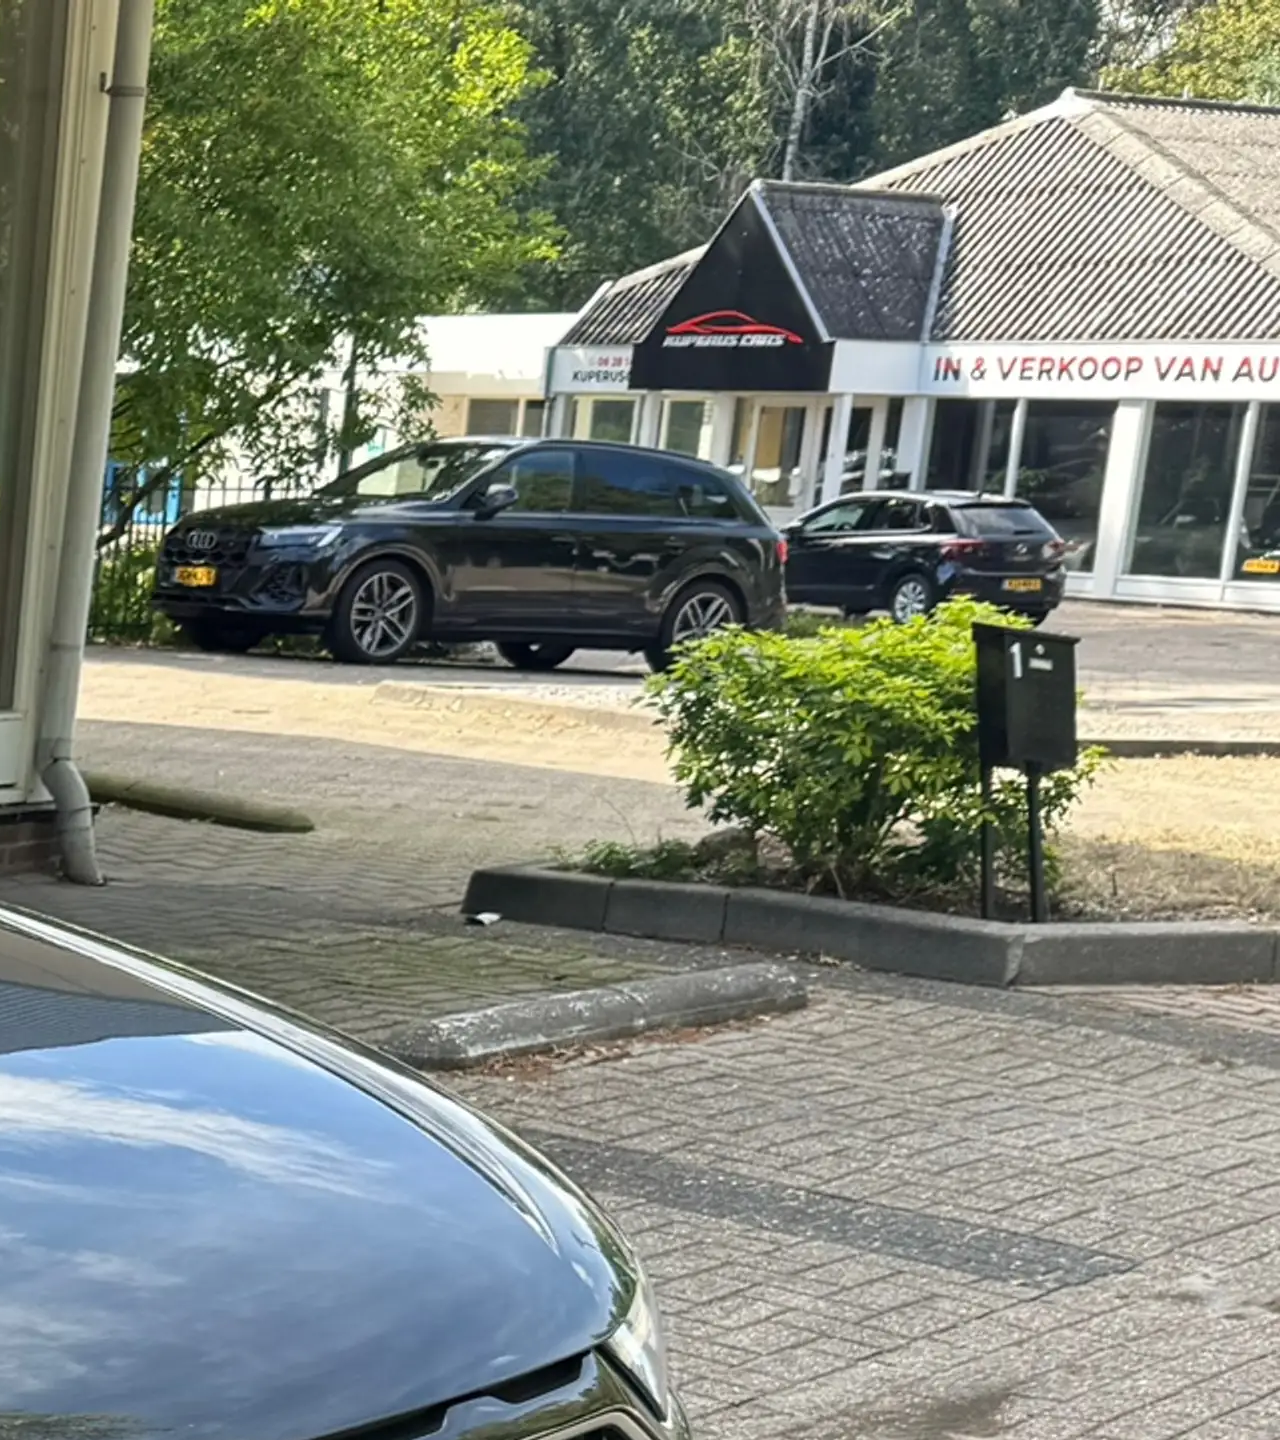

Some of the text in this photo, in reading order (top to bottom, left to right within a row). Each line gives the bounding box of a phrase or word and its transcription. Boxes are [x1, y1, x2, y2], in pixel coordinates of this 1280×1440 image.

[662, 333, 787, 348] KUPERUS CARS
[933, 356, 1280, 382] IN & VERKOOP VAN AU
[1009, 641, 1022, 679] 1
